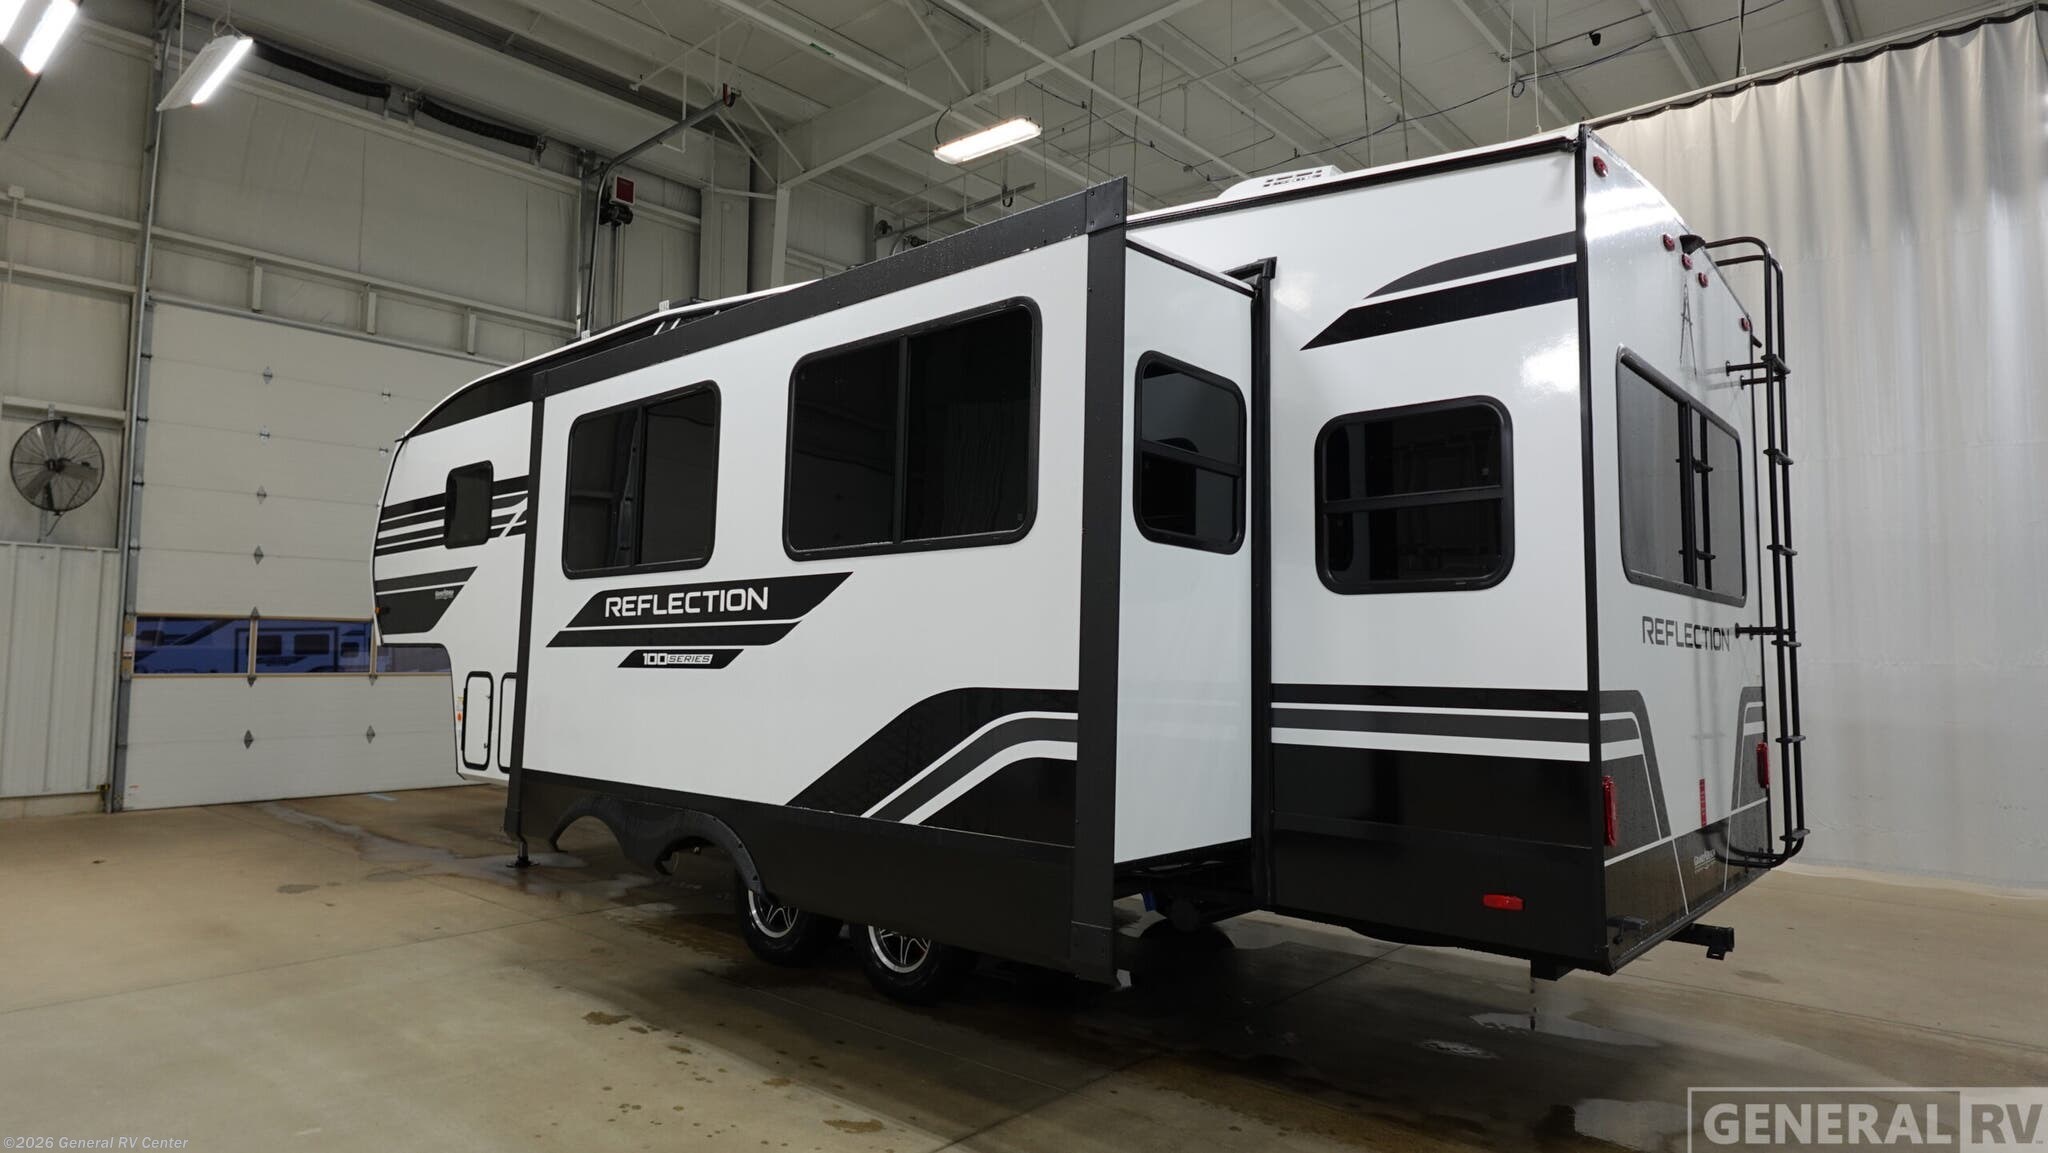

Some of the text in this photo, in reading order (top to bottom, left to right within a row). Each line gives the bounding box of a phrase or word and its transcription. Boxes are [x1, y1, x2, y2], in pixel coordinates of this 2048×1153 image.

[605, 587, 769, 617] REFLECTION
[1642, 615, 1730, 652] REFLECTION
[668, 654, 712, 664] SERIES
